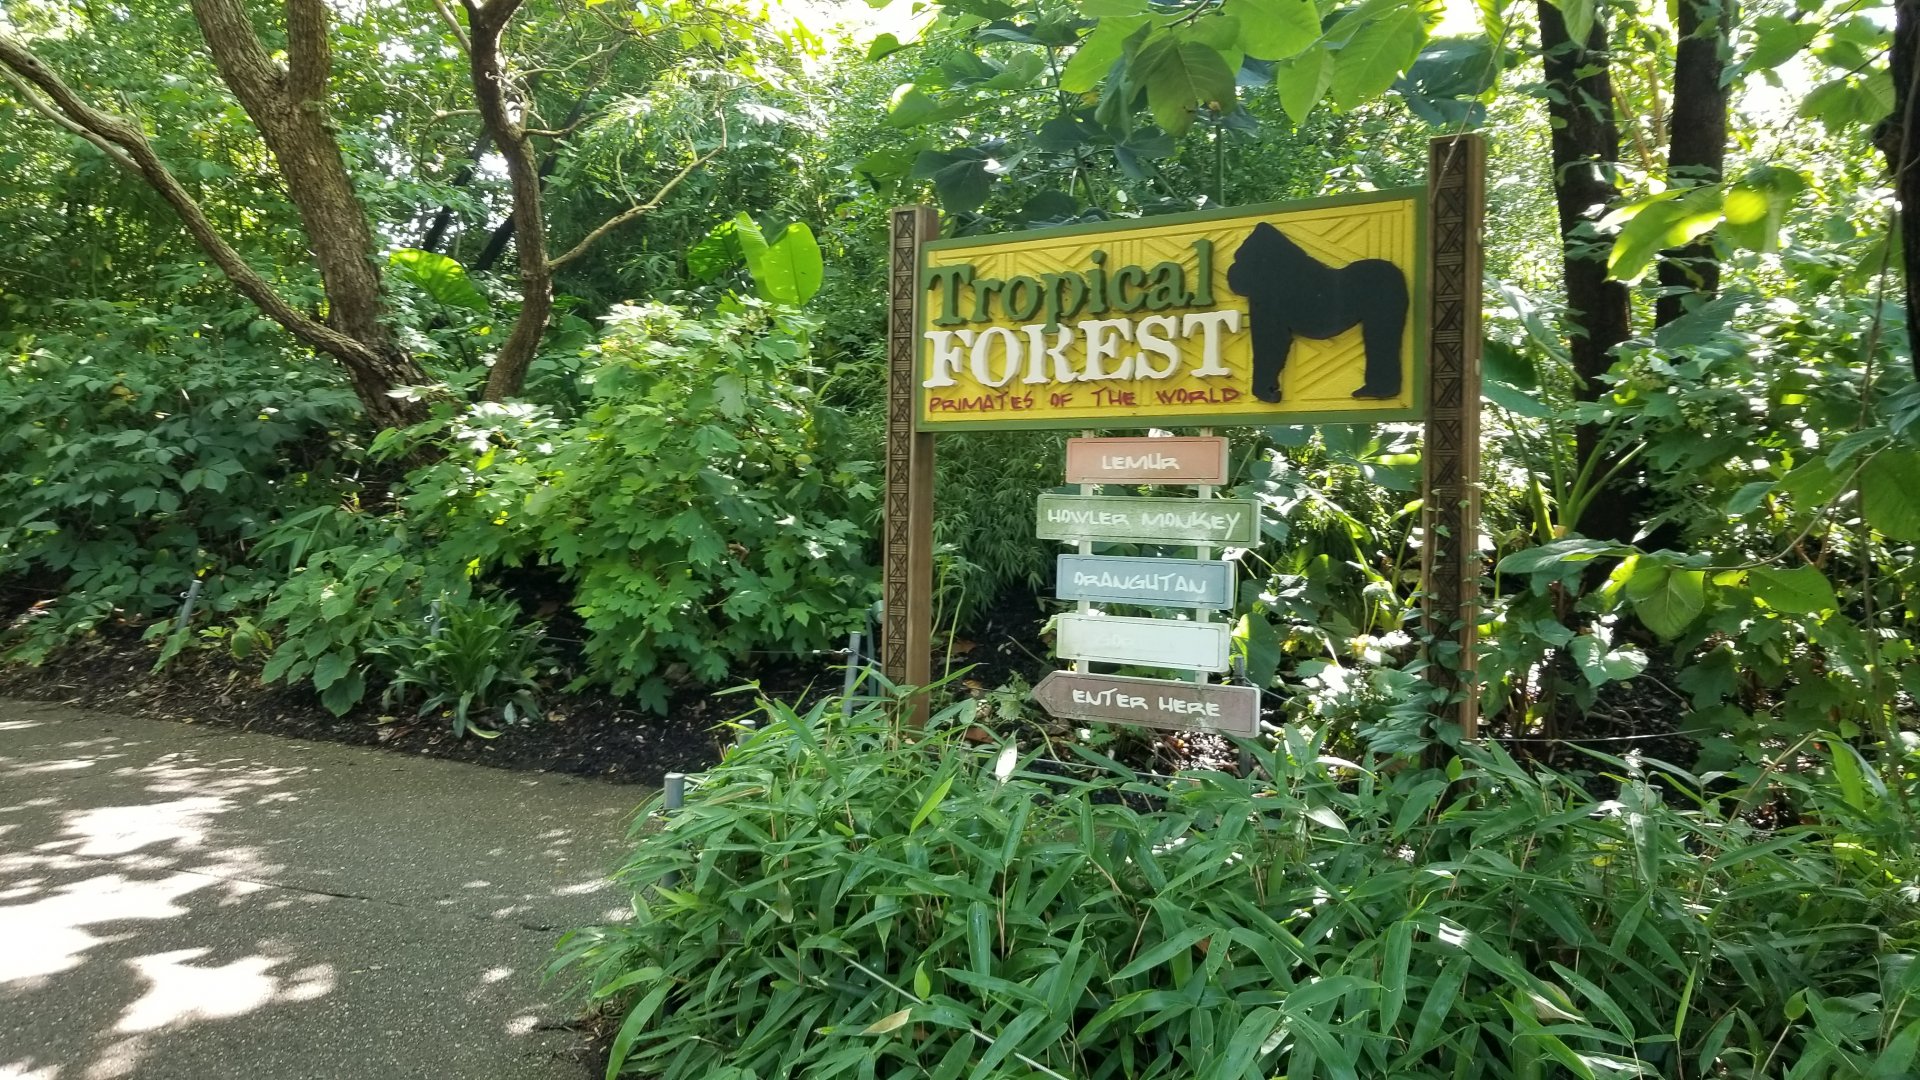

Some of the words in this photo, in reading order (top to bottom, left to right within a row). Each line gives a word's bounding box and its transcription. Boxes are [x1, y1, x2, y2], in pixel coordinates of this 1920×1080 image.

[924, 239, 1216, 335] Tropical
[922, 309, 1241, 388] FOREST
[929, 391, 1034, 412] PRIMATES
[1050, 392, 1073, 407] OF
[1091, 386, 1137, 407] THE
[1156, 387, 1241, 404] WORLD
[1102, 453, 1180, 470] LEMUR
[1048, 508, 1130, 526] HOWLER
[1141, 511, 1241, 540] MONKEY
[1073, 571, 1207, 594] ORANGUTAN
[1072, 688, 1149, 710] ENTER
[1158, 696, 1222, 717] HERE
